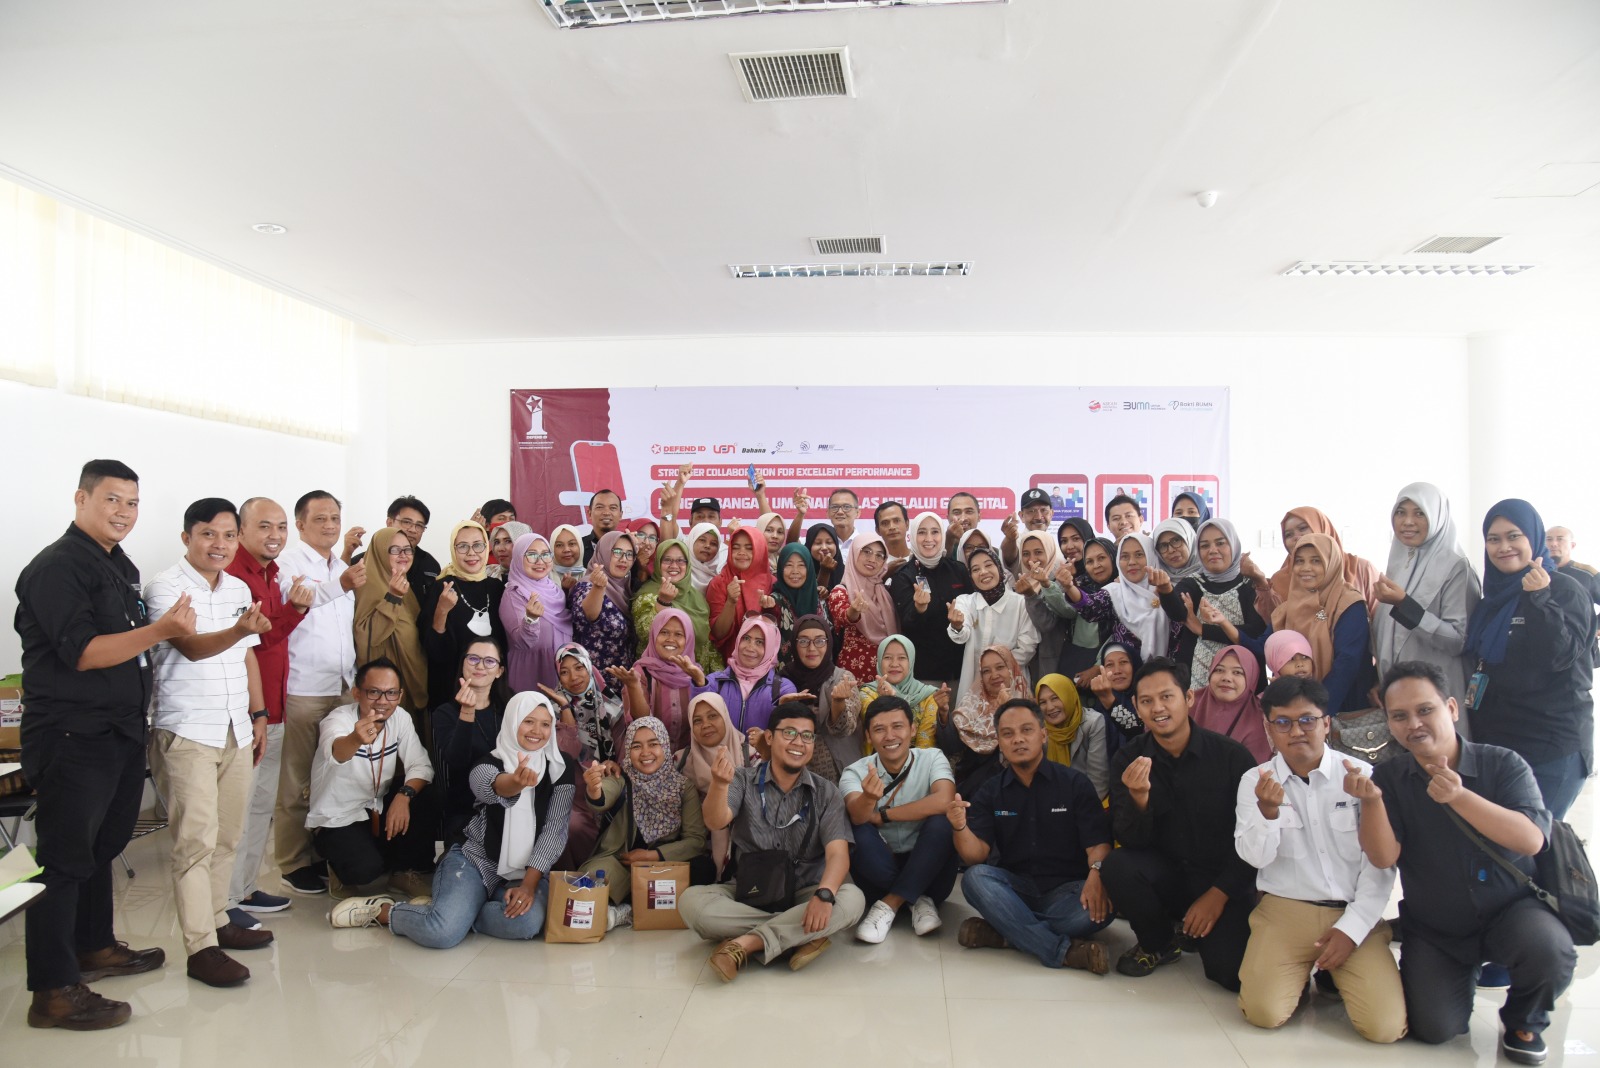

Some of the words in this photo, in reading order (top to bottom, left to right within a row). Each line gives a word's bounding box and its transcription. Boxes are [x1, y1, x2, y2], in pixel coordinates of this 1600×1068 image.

[658, 468, 704, 477] STROER
[777, 467, 795, 477] FOR
[796, 467, 844, 477] EXCELLENT
[845, 467, 912, 477] PERFORMANCE
[806, 497, 830, 510] NAI
